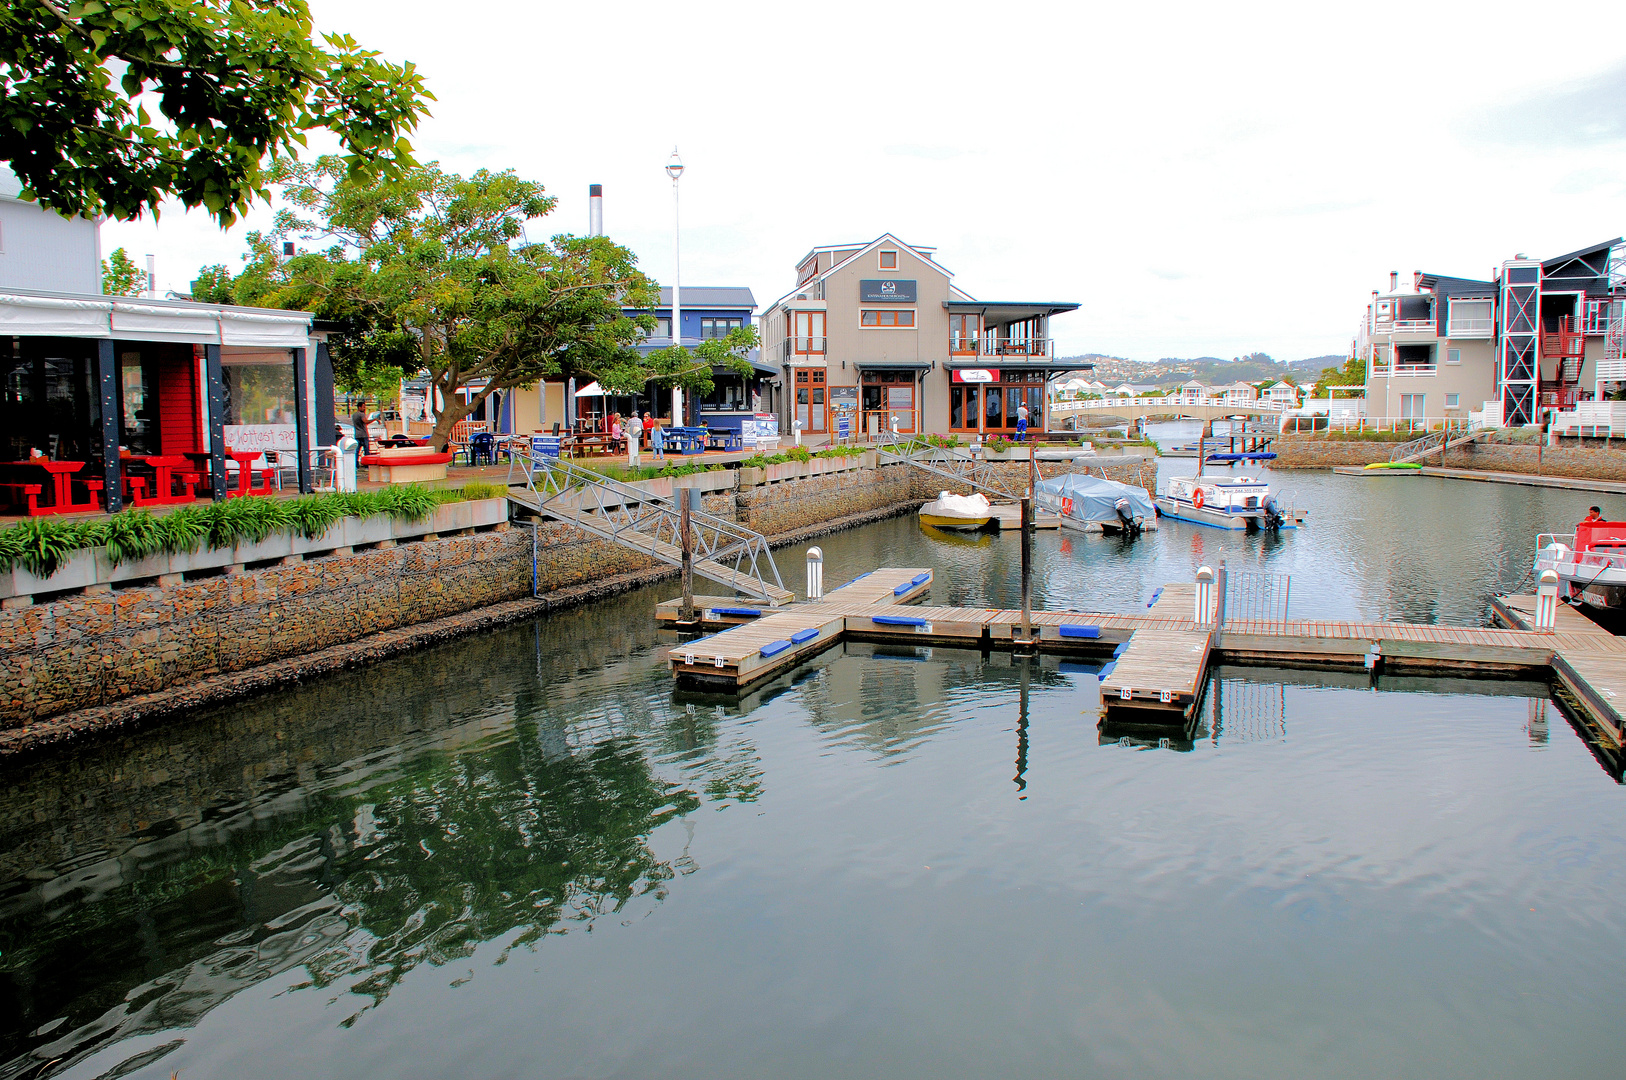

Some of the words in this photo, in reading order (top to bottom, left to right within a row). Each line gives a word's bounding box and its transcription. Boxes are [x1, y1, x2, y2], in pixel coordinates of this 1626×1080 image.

[237, 429, 275, 446] hottest
[278, 430, 297, 446] spo
[686, 655, 693, 663] 19
[716, 658, 723, 666] 17
[1121, 689, 1131, 698] 15
[1161, 692, 1170, 700] 13
